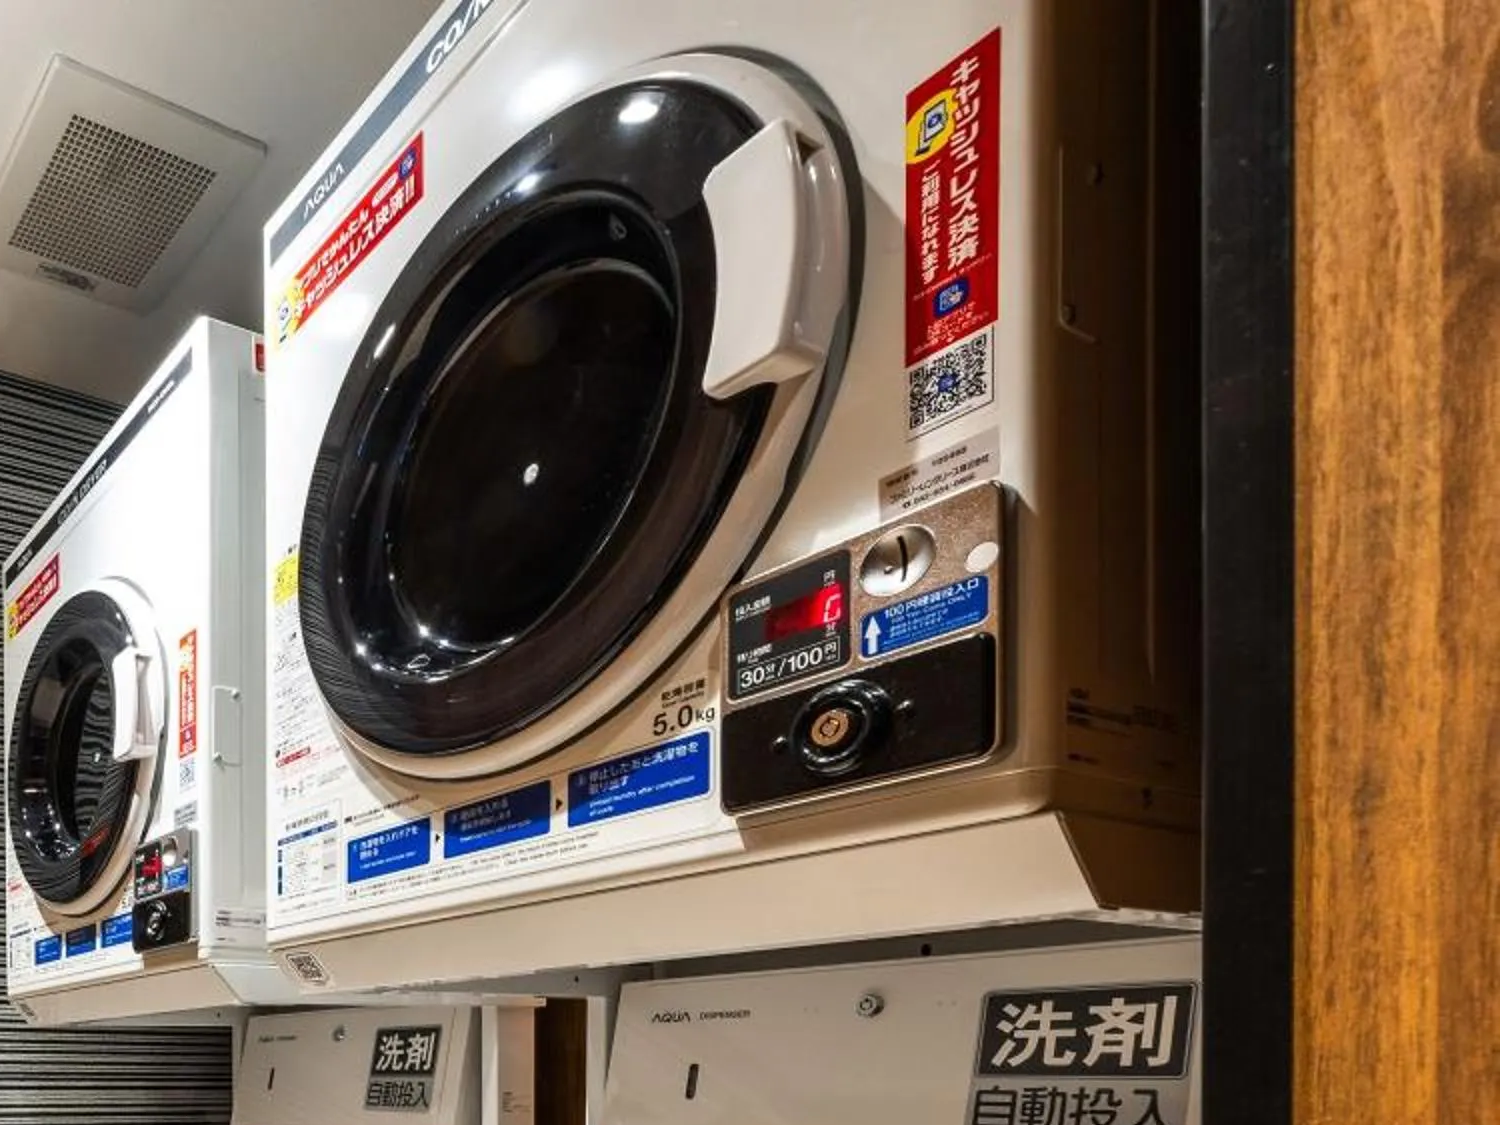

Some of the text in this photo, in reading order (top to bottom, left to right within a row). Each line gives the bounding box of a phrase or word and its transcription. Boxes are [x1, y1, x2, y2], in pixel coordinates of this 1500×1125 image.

[947, 56, 981, 270] キャッシュレス決済
[302, 162, 345, 220] AQUA
[652, 1012, 691, 1023] AQUA
[991, 995, 1179, 1068] 洗剤
[375, 1031, 436, 1071] 洗剤
[366, 1081, 430, 1109] 自動投入
